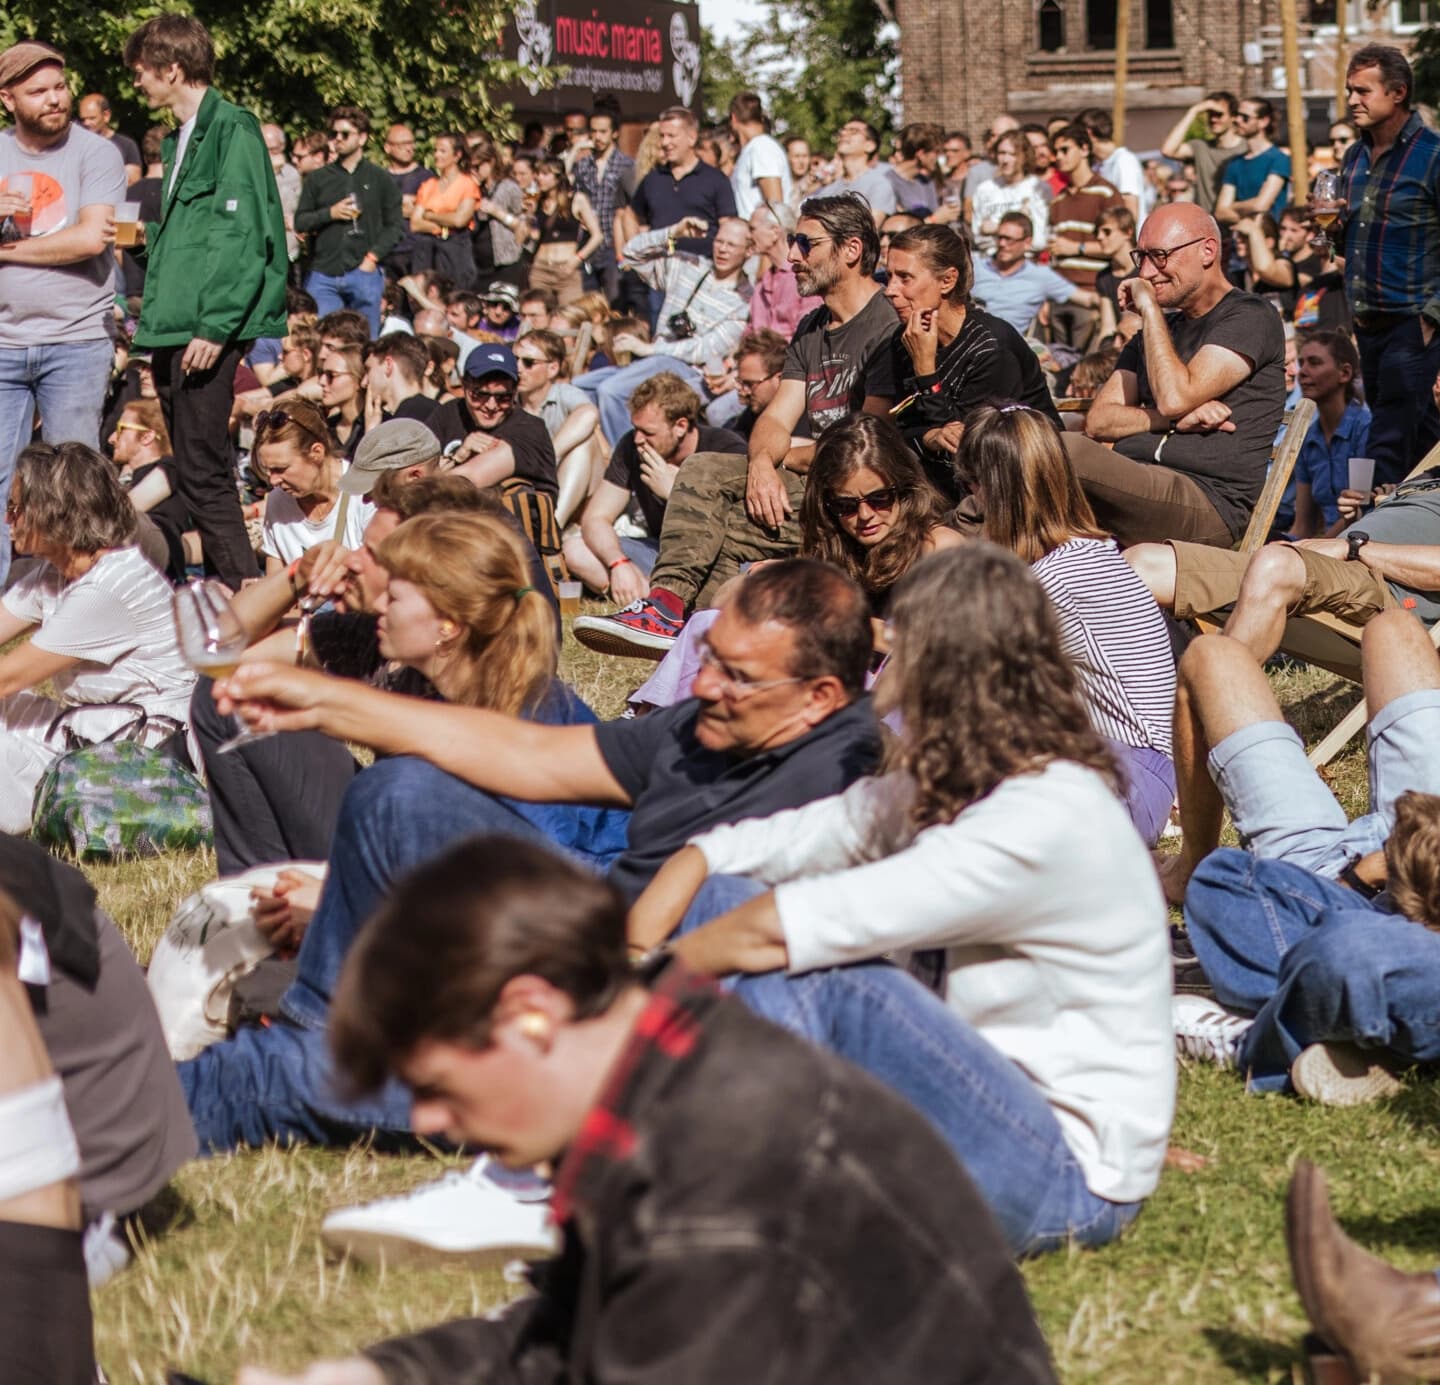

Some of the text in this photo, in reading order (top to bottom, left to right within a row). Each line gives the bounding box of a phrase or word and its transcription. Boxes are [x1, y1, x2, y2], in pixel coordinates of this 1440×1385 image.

[556, 9, 662, 63] music mania
[574, 64, 591, 87] and
[591, 69, 621, 93] grooves
[622, 67, 643, 91] since
